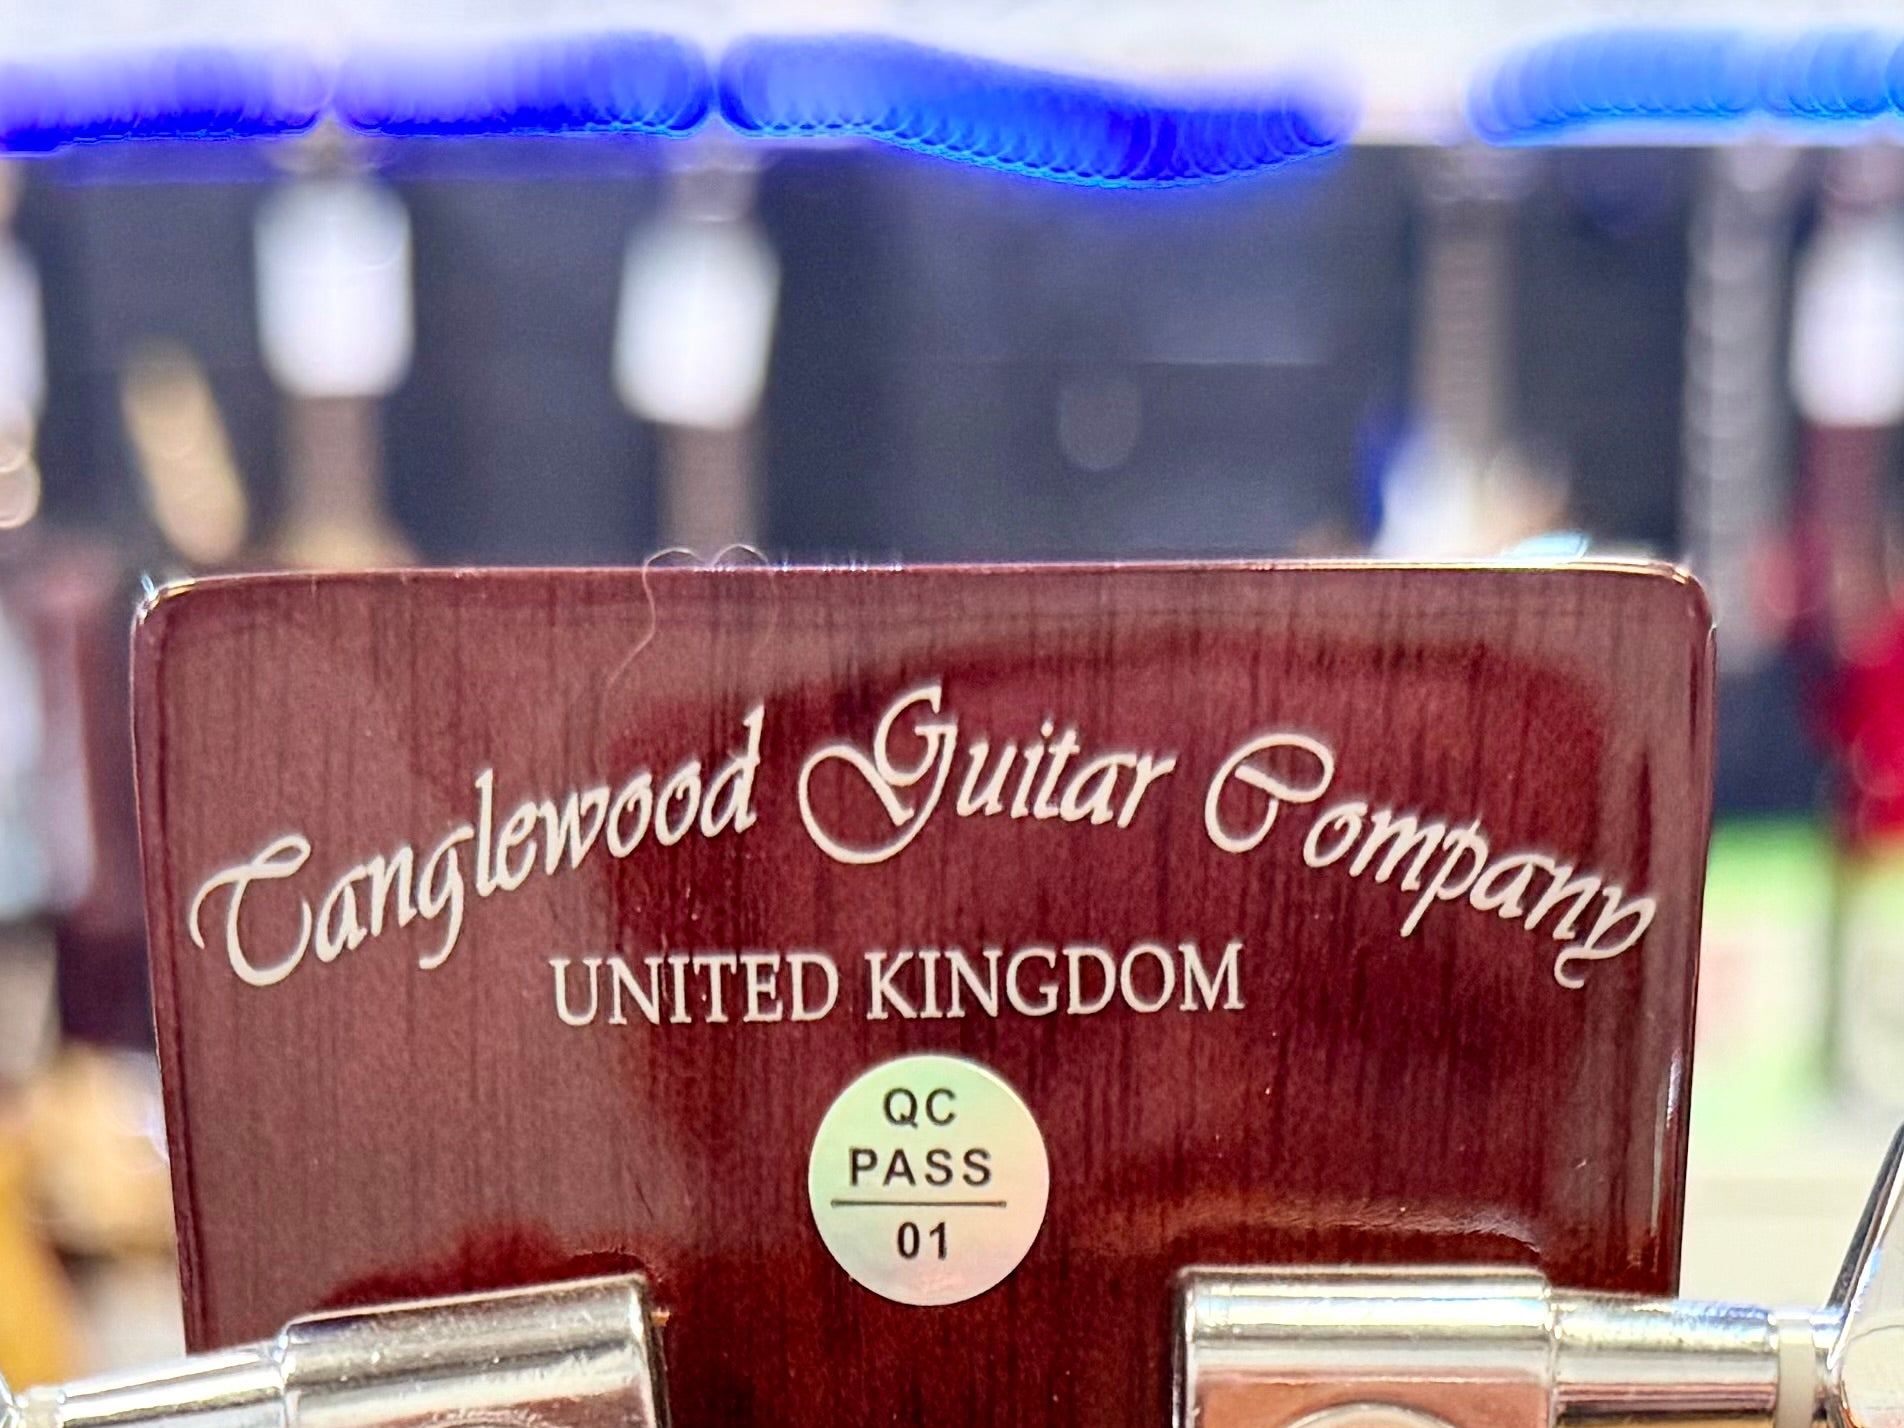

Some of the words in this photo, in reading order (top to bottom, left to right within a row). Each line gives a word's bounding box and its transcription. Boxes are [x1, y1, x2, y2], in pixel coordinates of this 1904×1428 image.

[190, 705, 765, 986] Tanglewood
[798, 684, 1175, 864] Guitar
[1205, 732, 1655, 988] Company
[549, 955, 838, 1026] UNITED
[865, 942, 1245, 1020] KINGDOM
[883, 1086, 957, 1129] QC
[849, 1147, 993, 1188] PASS
[896, 1221, 950, 1261] 01
